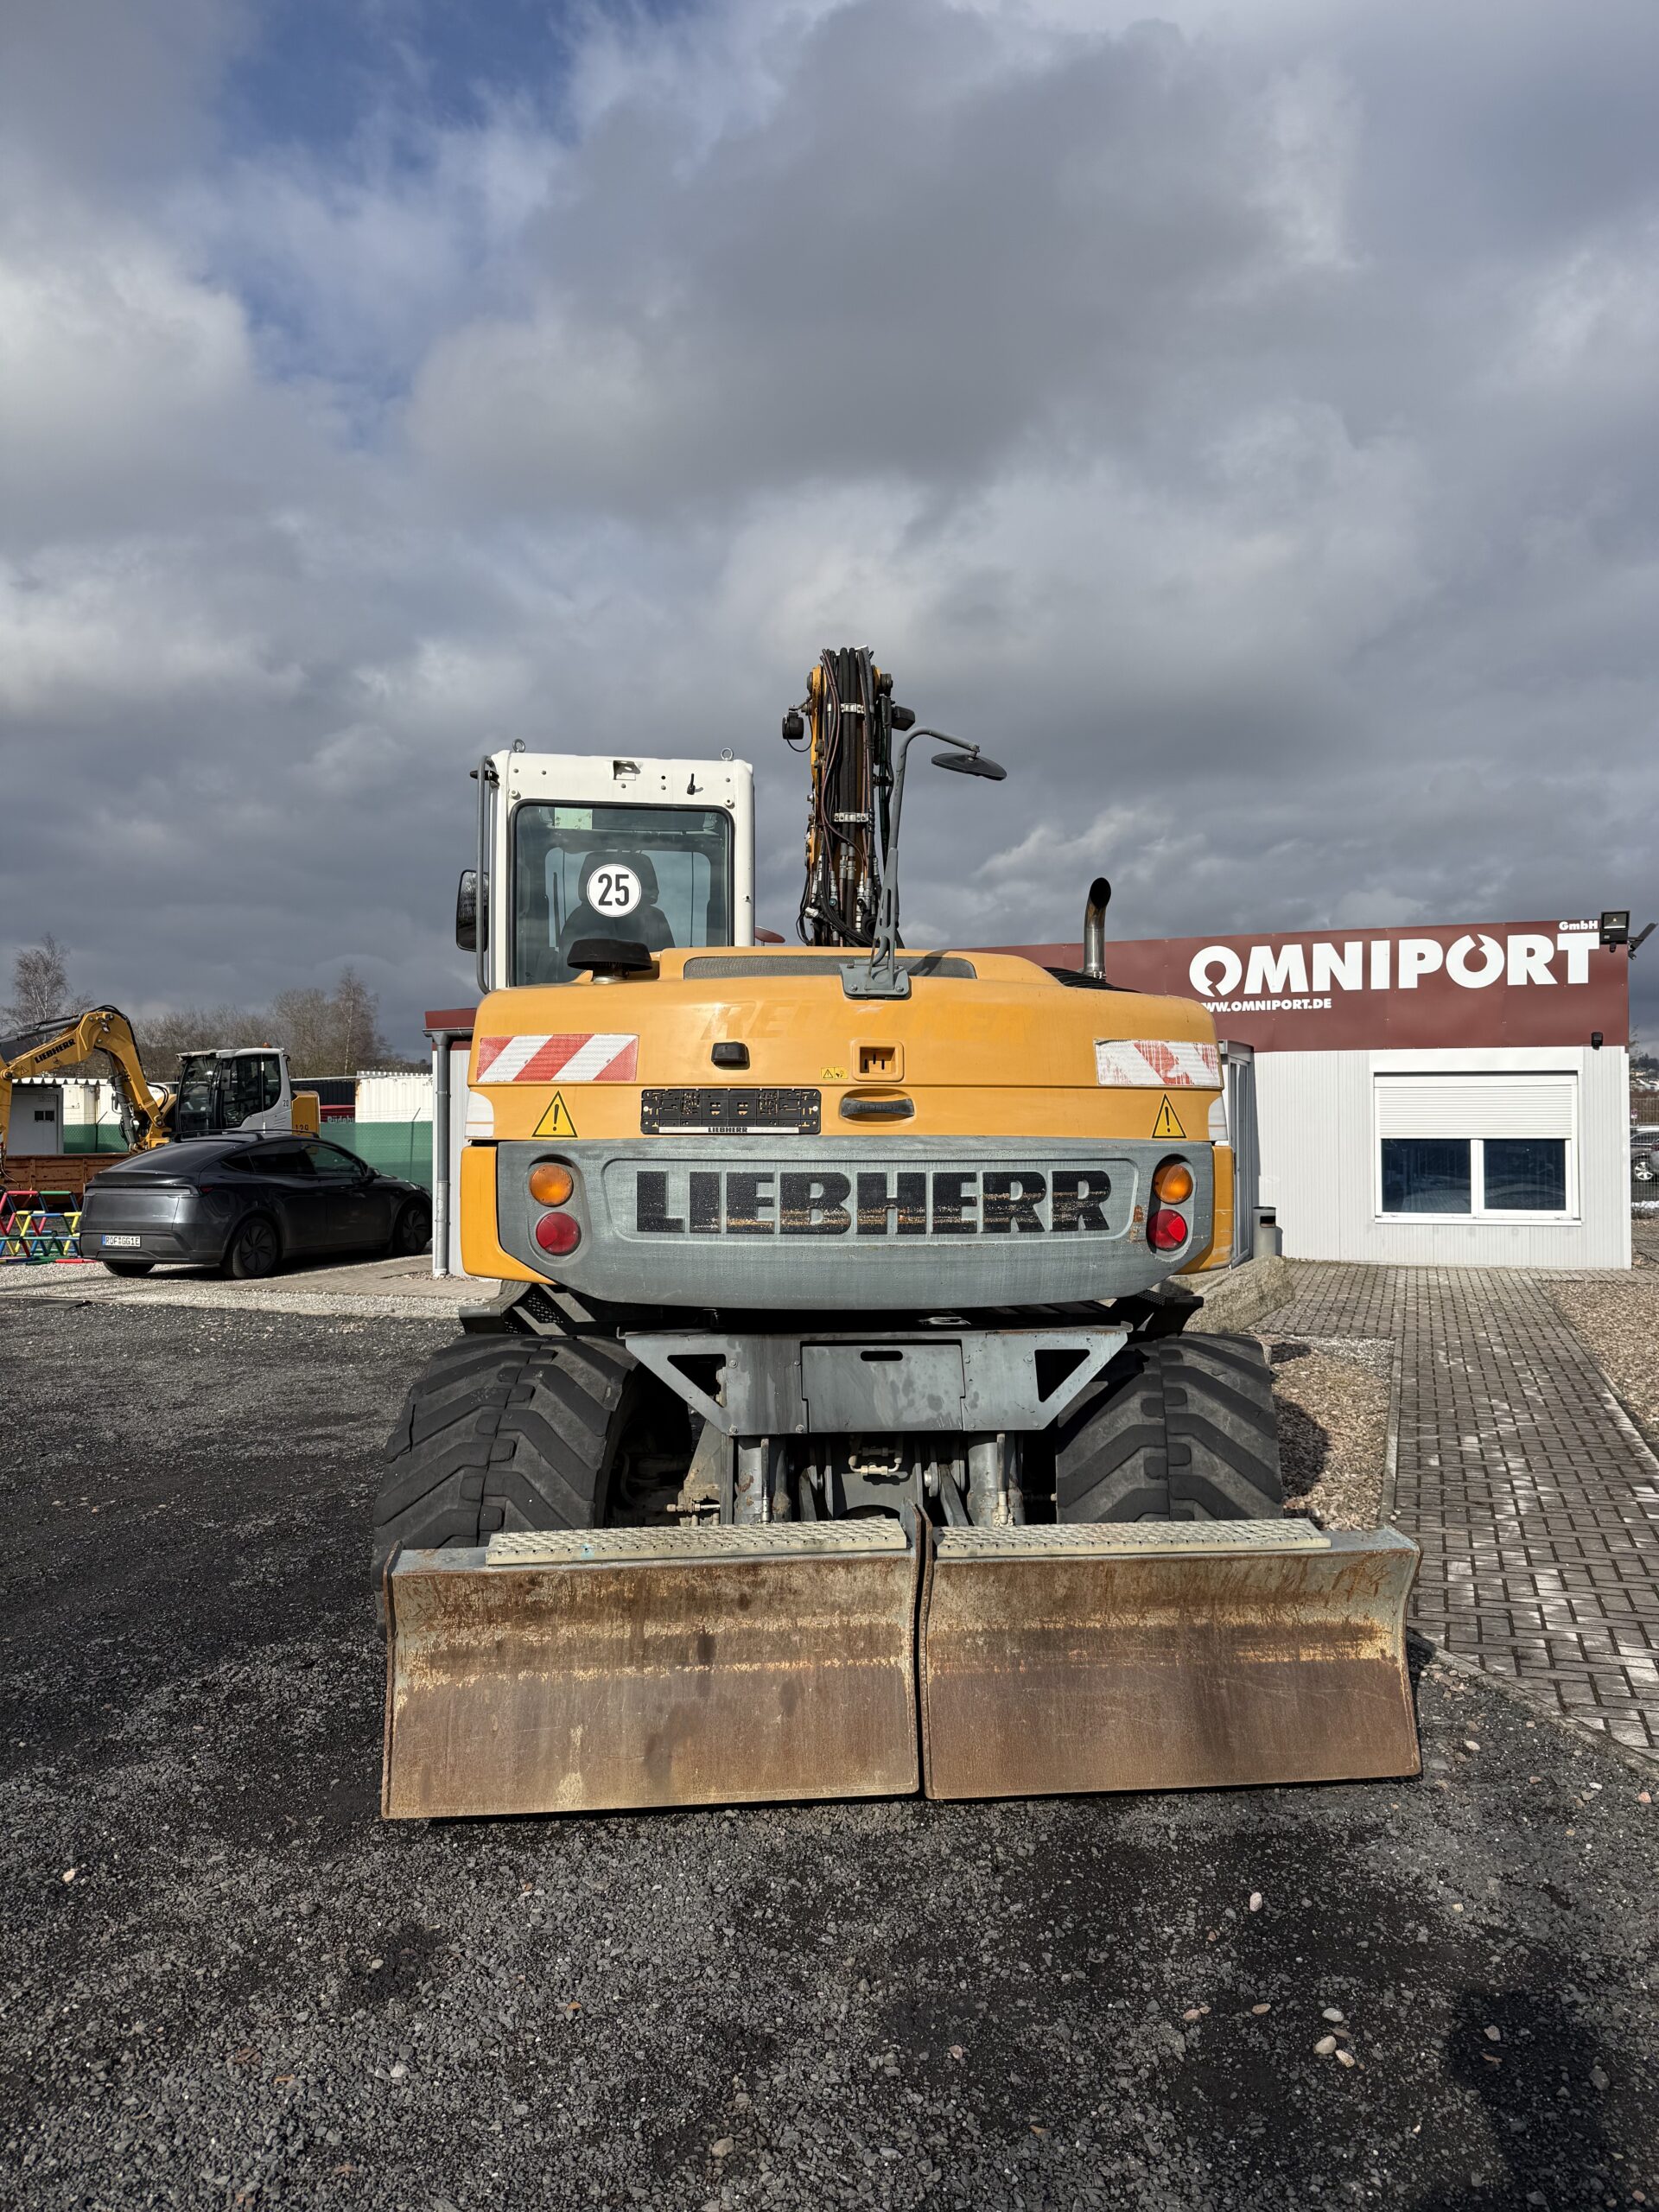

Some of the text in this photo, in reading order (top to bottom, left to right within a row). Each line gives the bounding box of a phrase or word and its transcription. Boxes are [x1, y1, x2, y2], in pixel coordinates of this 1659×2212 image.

[598, 874, 629, 906] 25
[1559, 920, 1599, 931] GmbH
[1188, 932, 1599, 997] OMNIPORT
[1200, 998, 1332, 1013] WW.OMNIPORT.DE
[35, 1039, 76, 1064] LIEBHERR
[637, 1170, 1111, 1235] LIEBHERR
